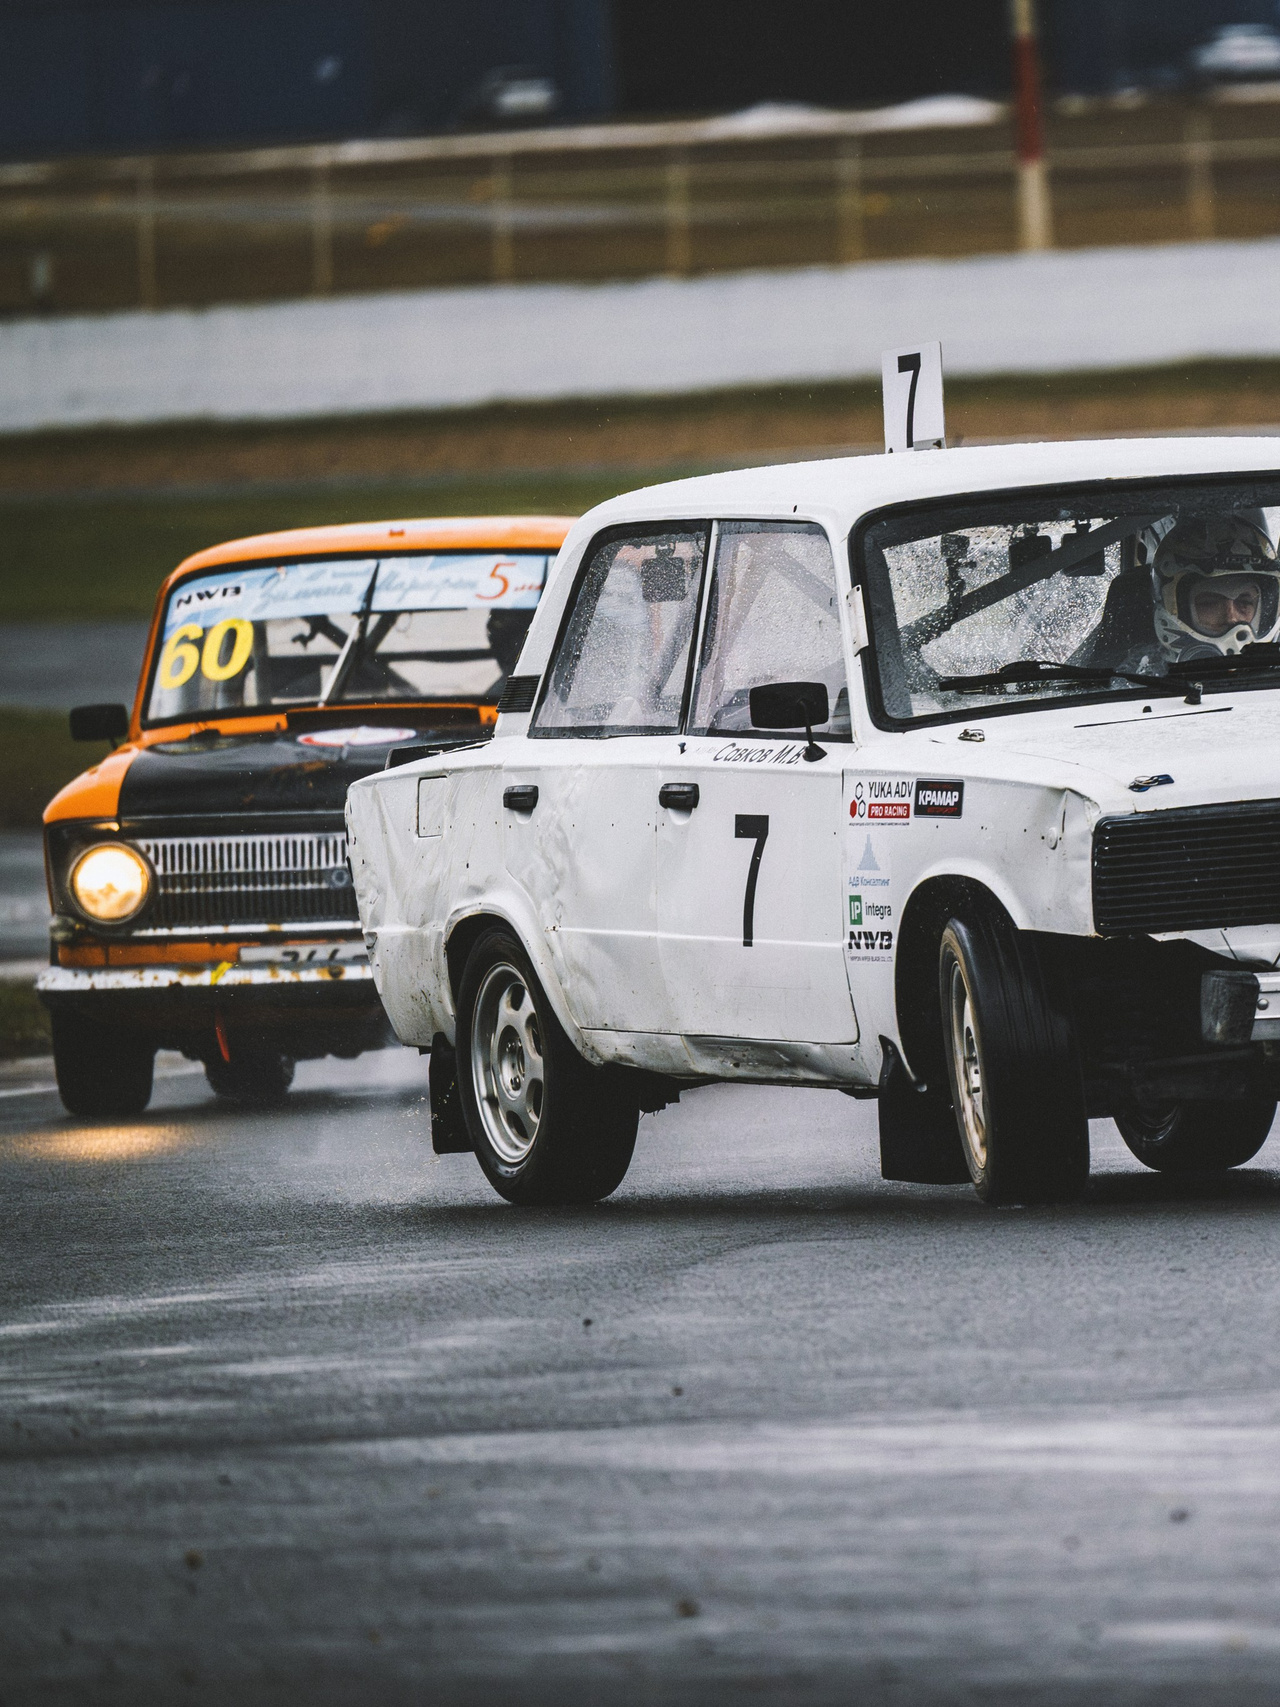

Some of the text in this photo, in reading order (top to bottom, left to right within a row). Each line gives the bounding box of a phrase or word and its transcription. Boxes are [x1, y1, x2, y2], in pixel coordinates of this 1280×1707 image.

[897, 352, 921, 449] 7
[475, 562, 517, 601] 5
[176, 585, 241, 609] NWB
[159, 618, 254, 690] 60
[713, 742, 774, 762] Савков
[868, 781, 914, 798] YUKA ADV
[918, 790, 959, 806] КРАМАР
[870, 805, 908, 816] PRO RACING
[734, 814, 769, 947] 7
[865, 902, 892, 920] integra
[848, 931, 893, 950] NWB
